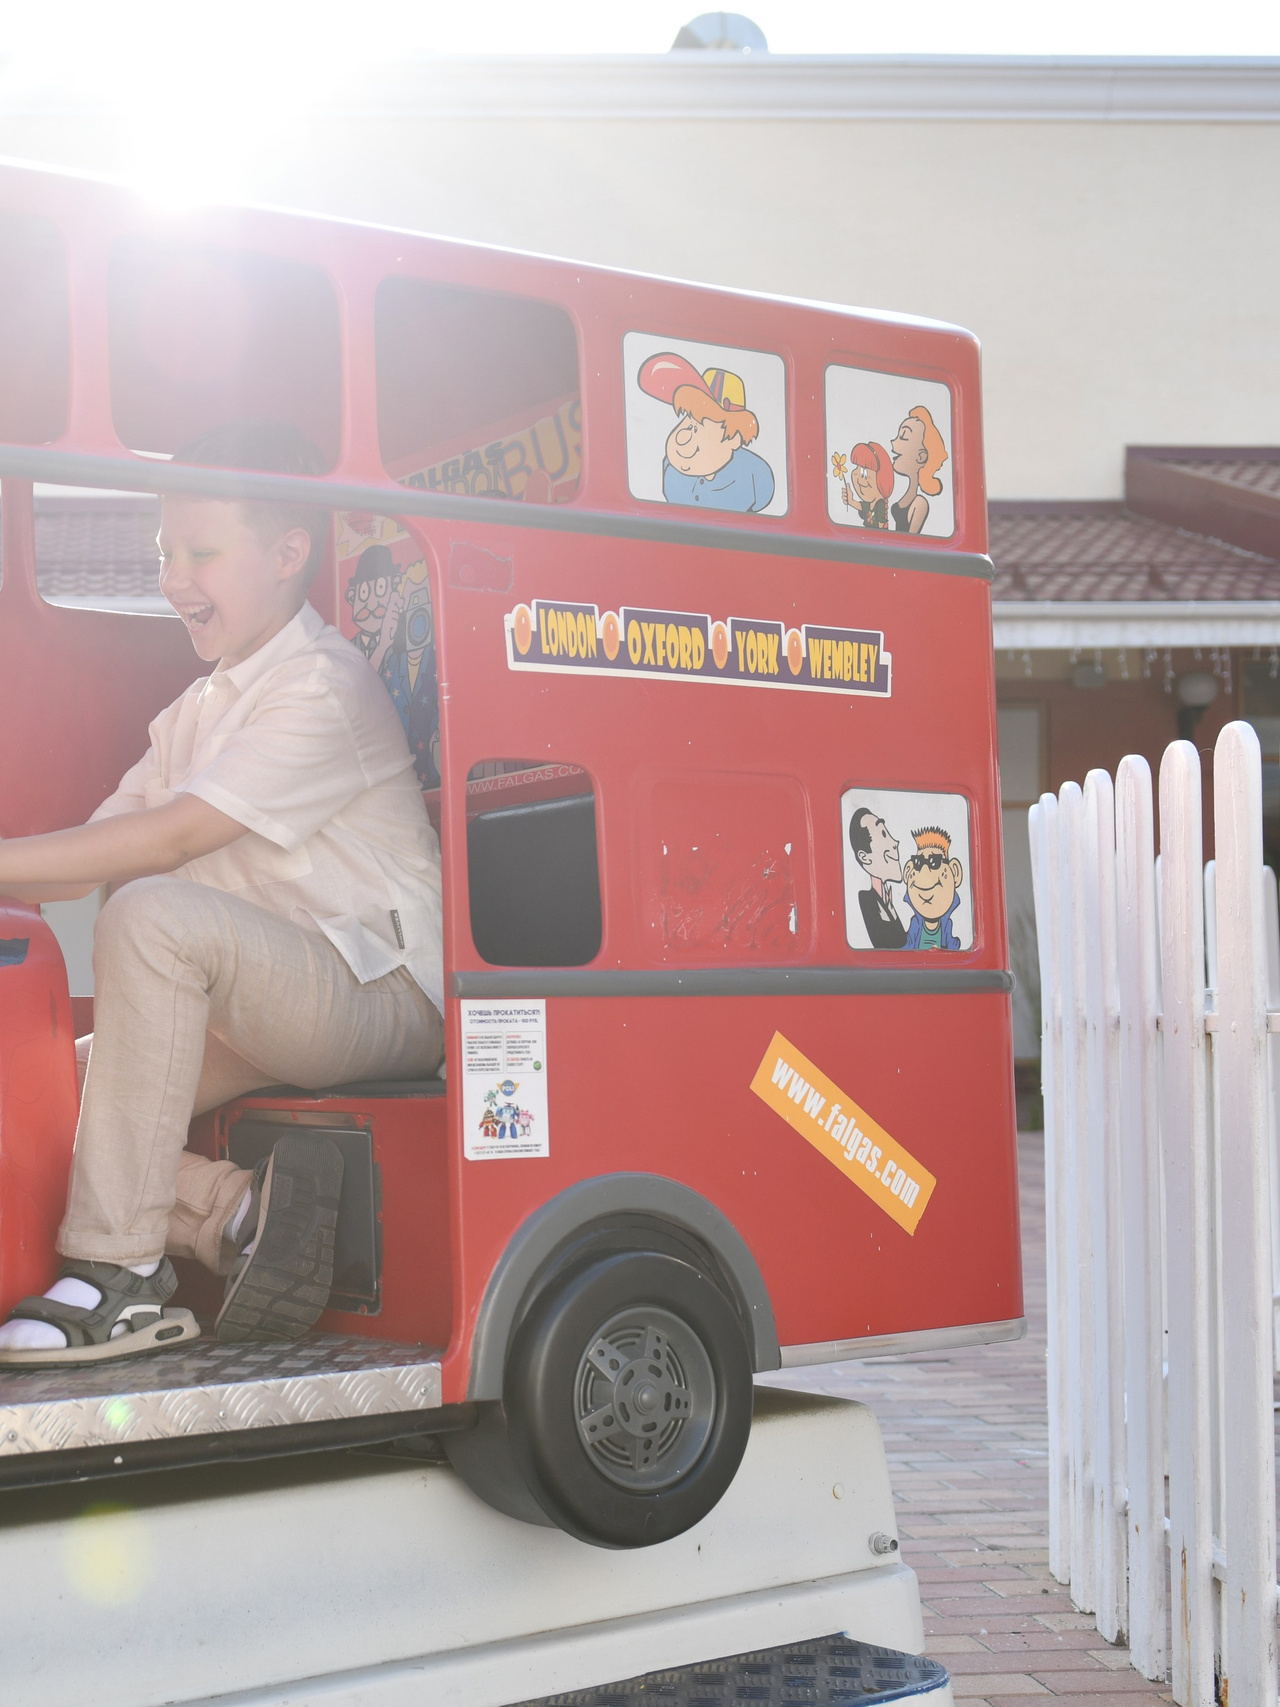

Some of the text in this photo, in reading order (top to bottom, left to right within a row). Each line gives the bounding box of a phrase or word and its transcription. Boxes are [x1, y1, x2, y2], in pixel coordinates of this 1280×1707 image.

[538, 608, 879, 684] LONDON OXFORD YORK WEMBLEY
[771, 1057, 920, 1209] www.falgas.com
